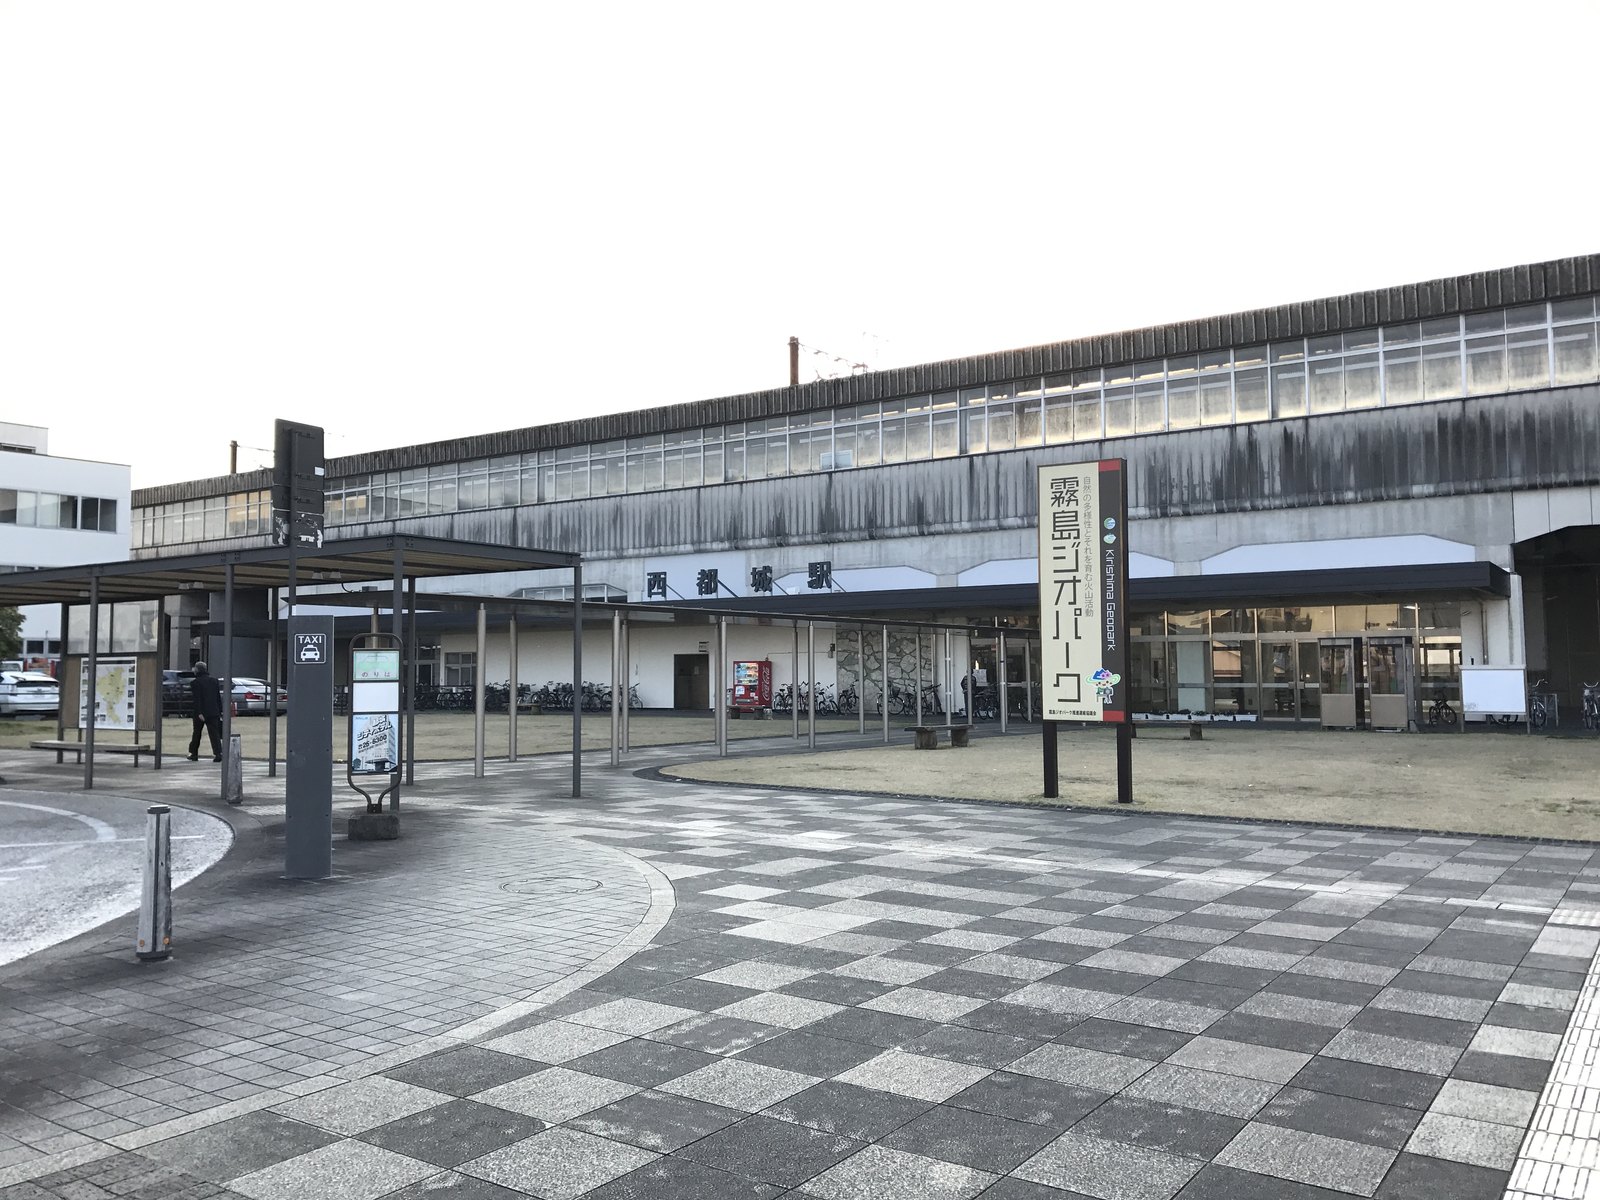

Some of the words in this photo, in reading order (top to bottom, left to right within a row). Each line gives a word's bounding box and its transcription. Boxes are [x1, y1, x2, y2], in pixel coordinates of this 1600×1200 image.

[1082, 476, 1094, 618] 自然の多様性とそれを育む火山活動
[647, 561, 832, 598] 西都城駅
[1050, 476, 1081, 703] 霧島ジオパーク
[1105, 549, 1115, 600] Kirishima
[298, 635, 322, 644] TAXI
[1106, 602, 1116, 651] Geopark
